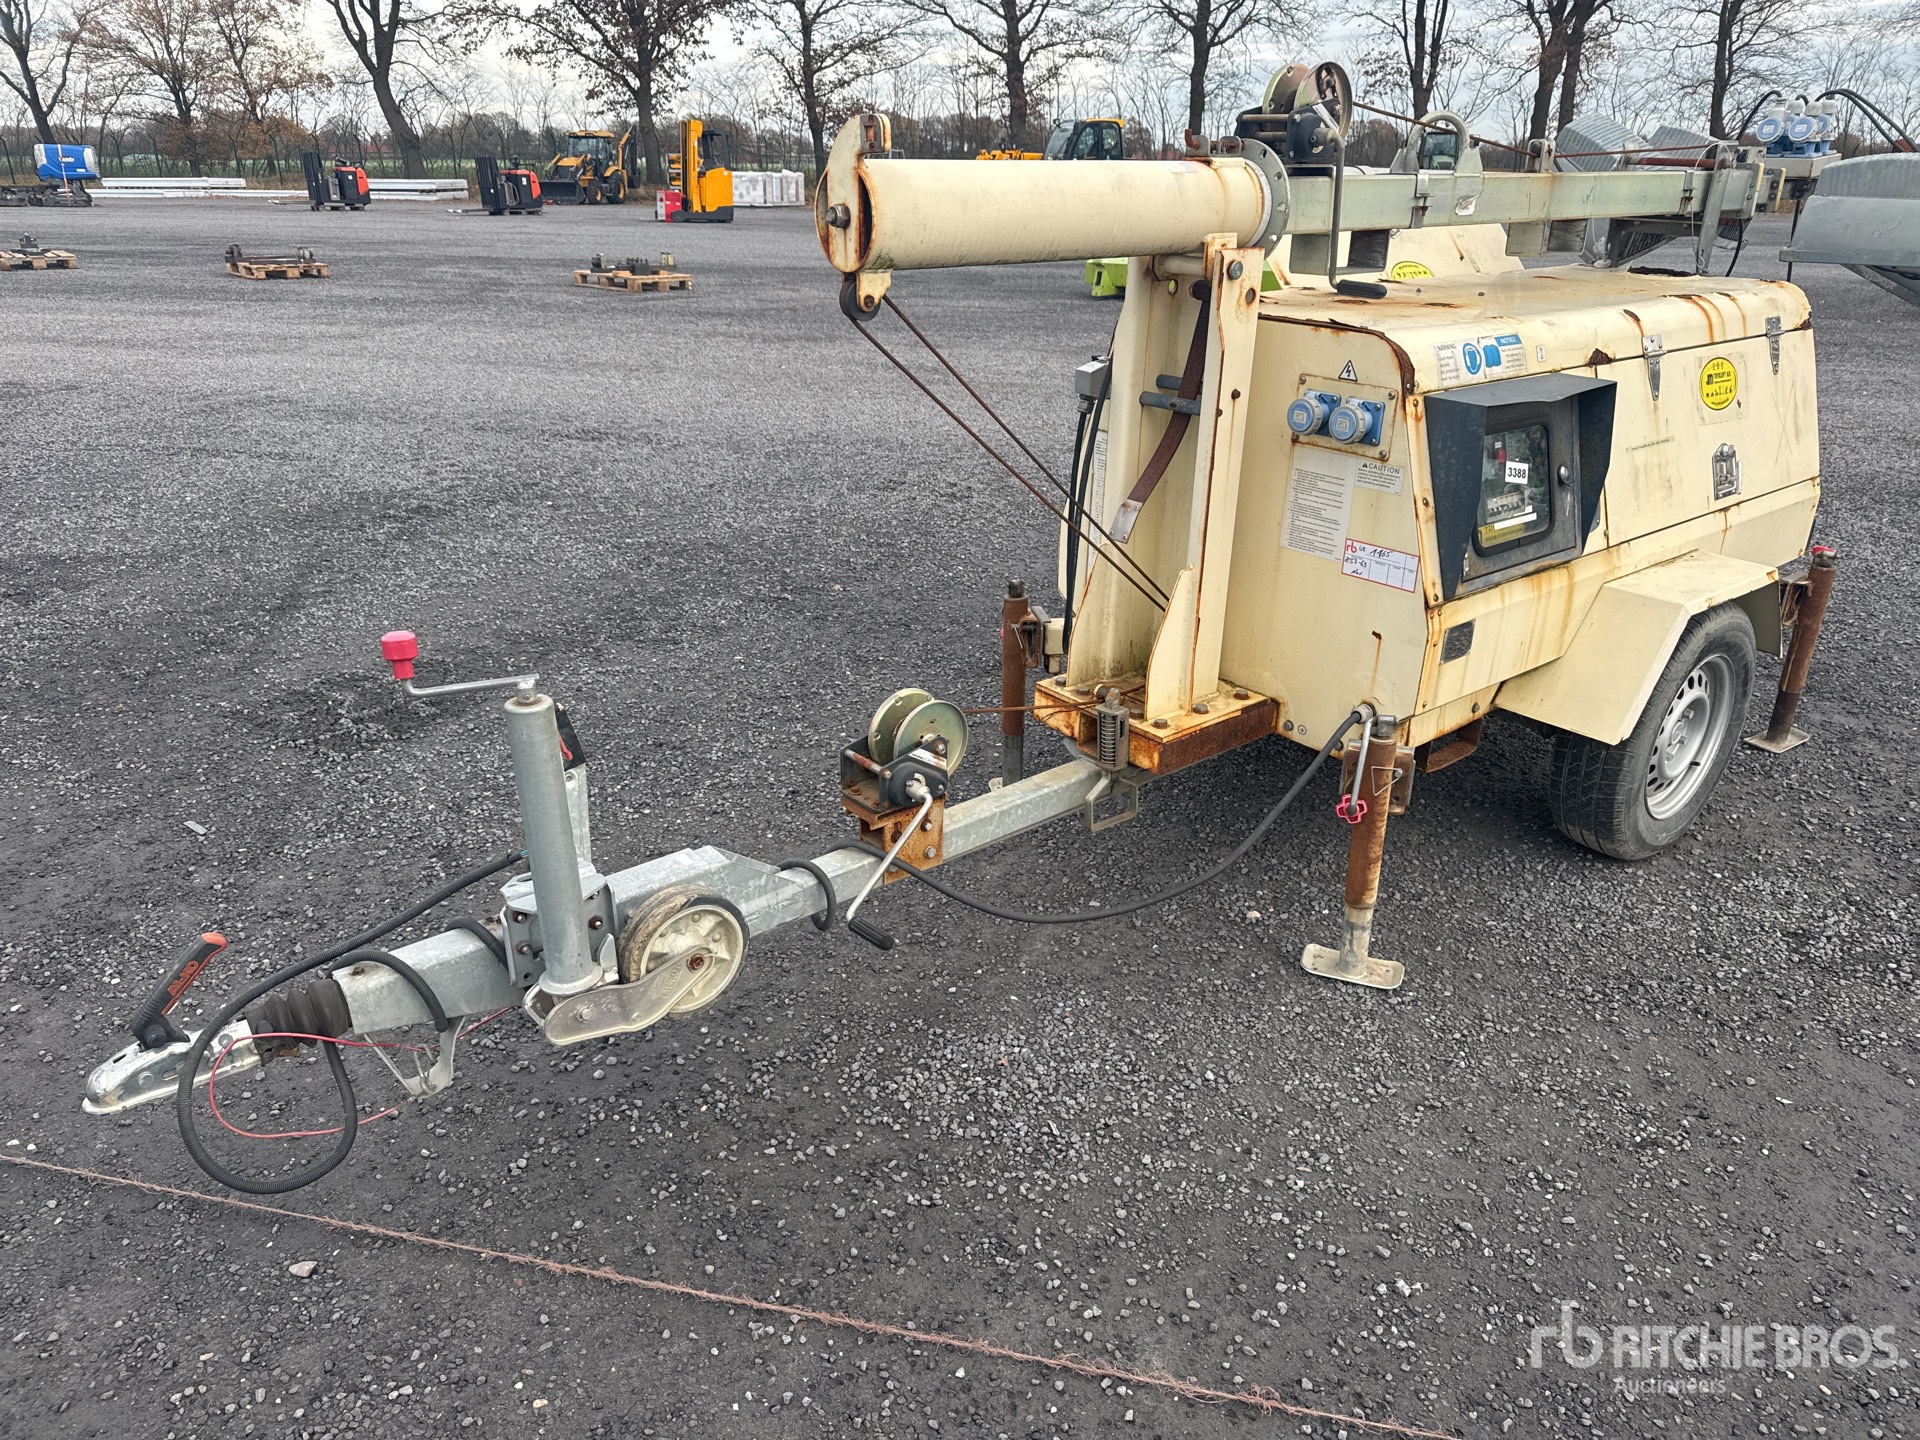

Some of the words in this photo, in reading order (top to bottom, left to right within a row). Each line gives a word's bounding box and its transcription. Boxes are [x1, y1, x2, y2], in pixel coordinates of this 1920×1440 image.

[1368, 462, 1400, 474] CAUTION
[1507, 467, 1527, 479] 3388
[1346, 541, 1357, 553] rb
[167, 961, 199, 997] AL-KO
